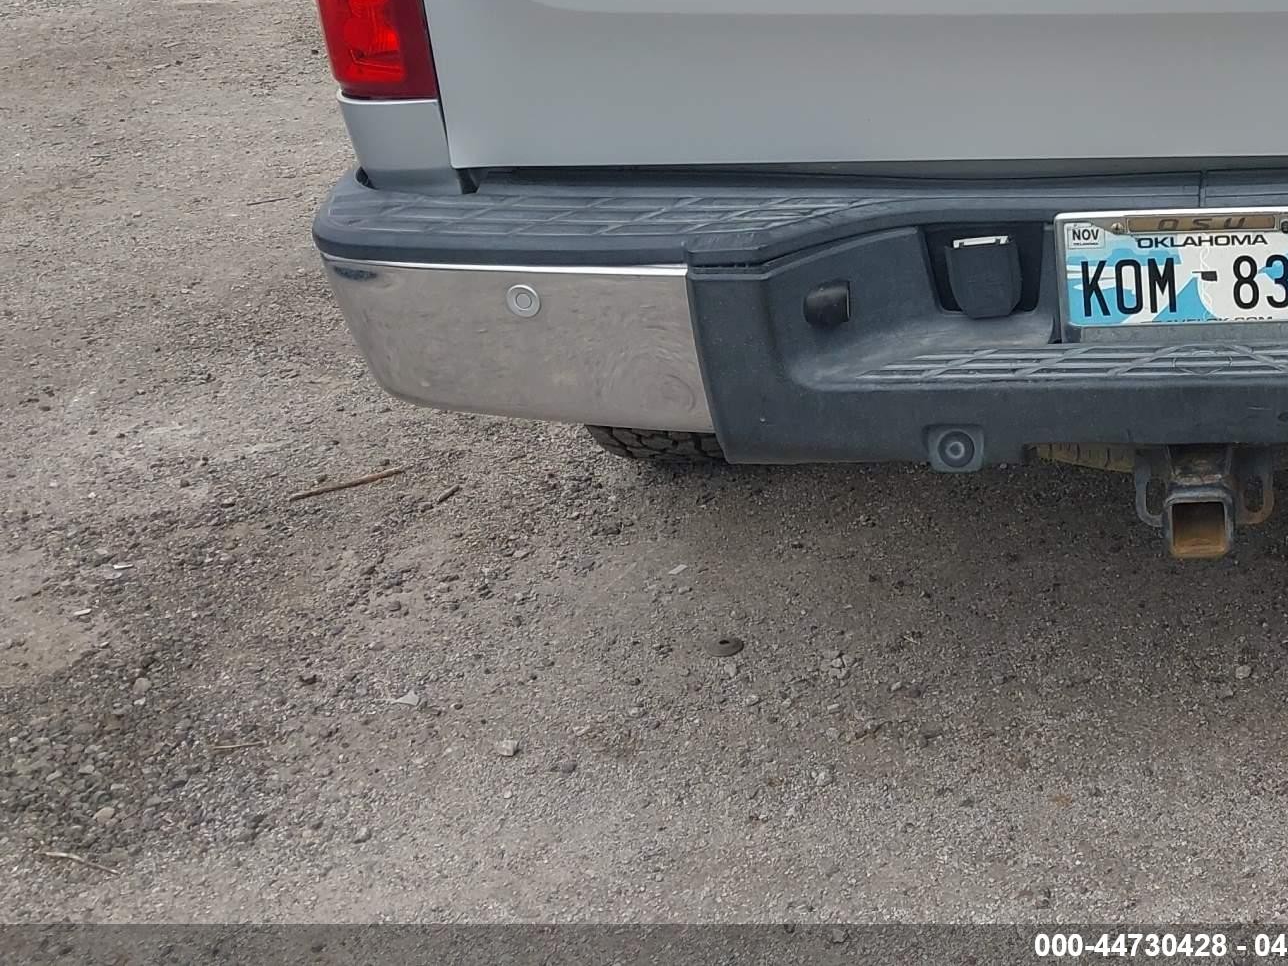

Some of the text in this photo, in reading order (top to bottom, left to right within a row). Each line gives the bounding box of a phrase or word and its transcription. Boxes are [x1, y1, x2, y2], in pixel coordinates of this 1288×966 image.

[1072, 228, 1100, 241] NOV
[1137, 234, 1268, 249] OKLAHOMA
[1080, 257, 1177, 317] KOM
